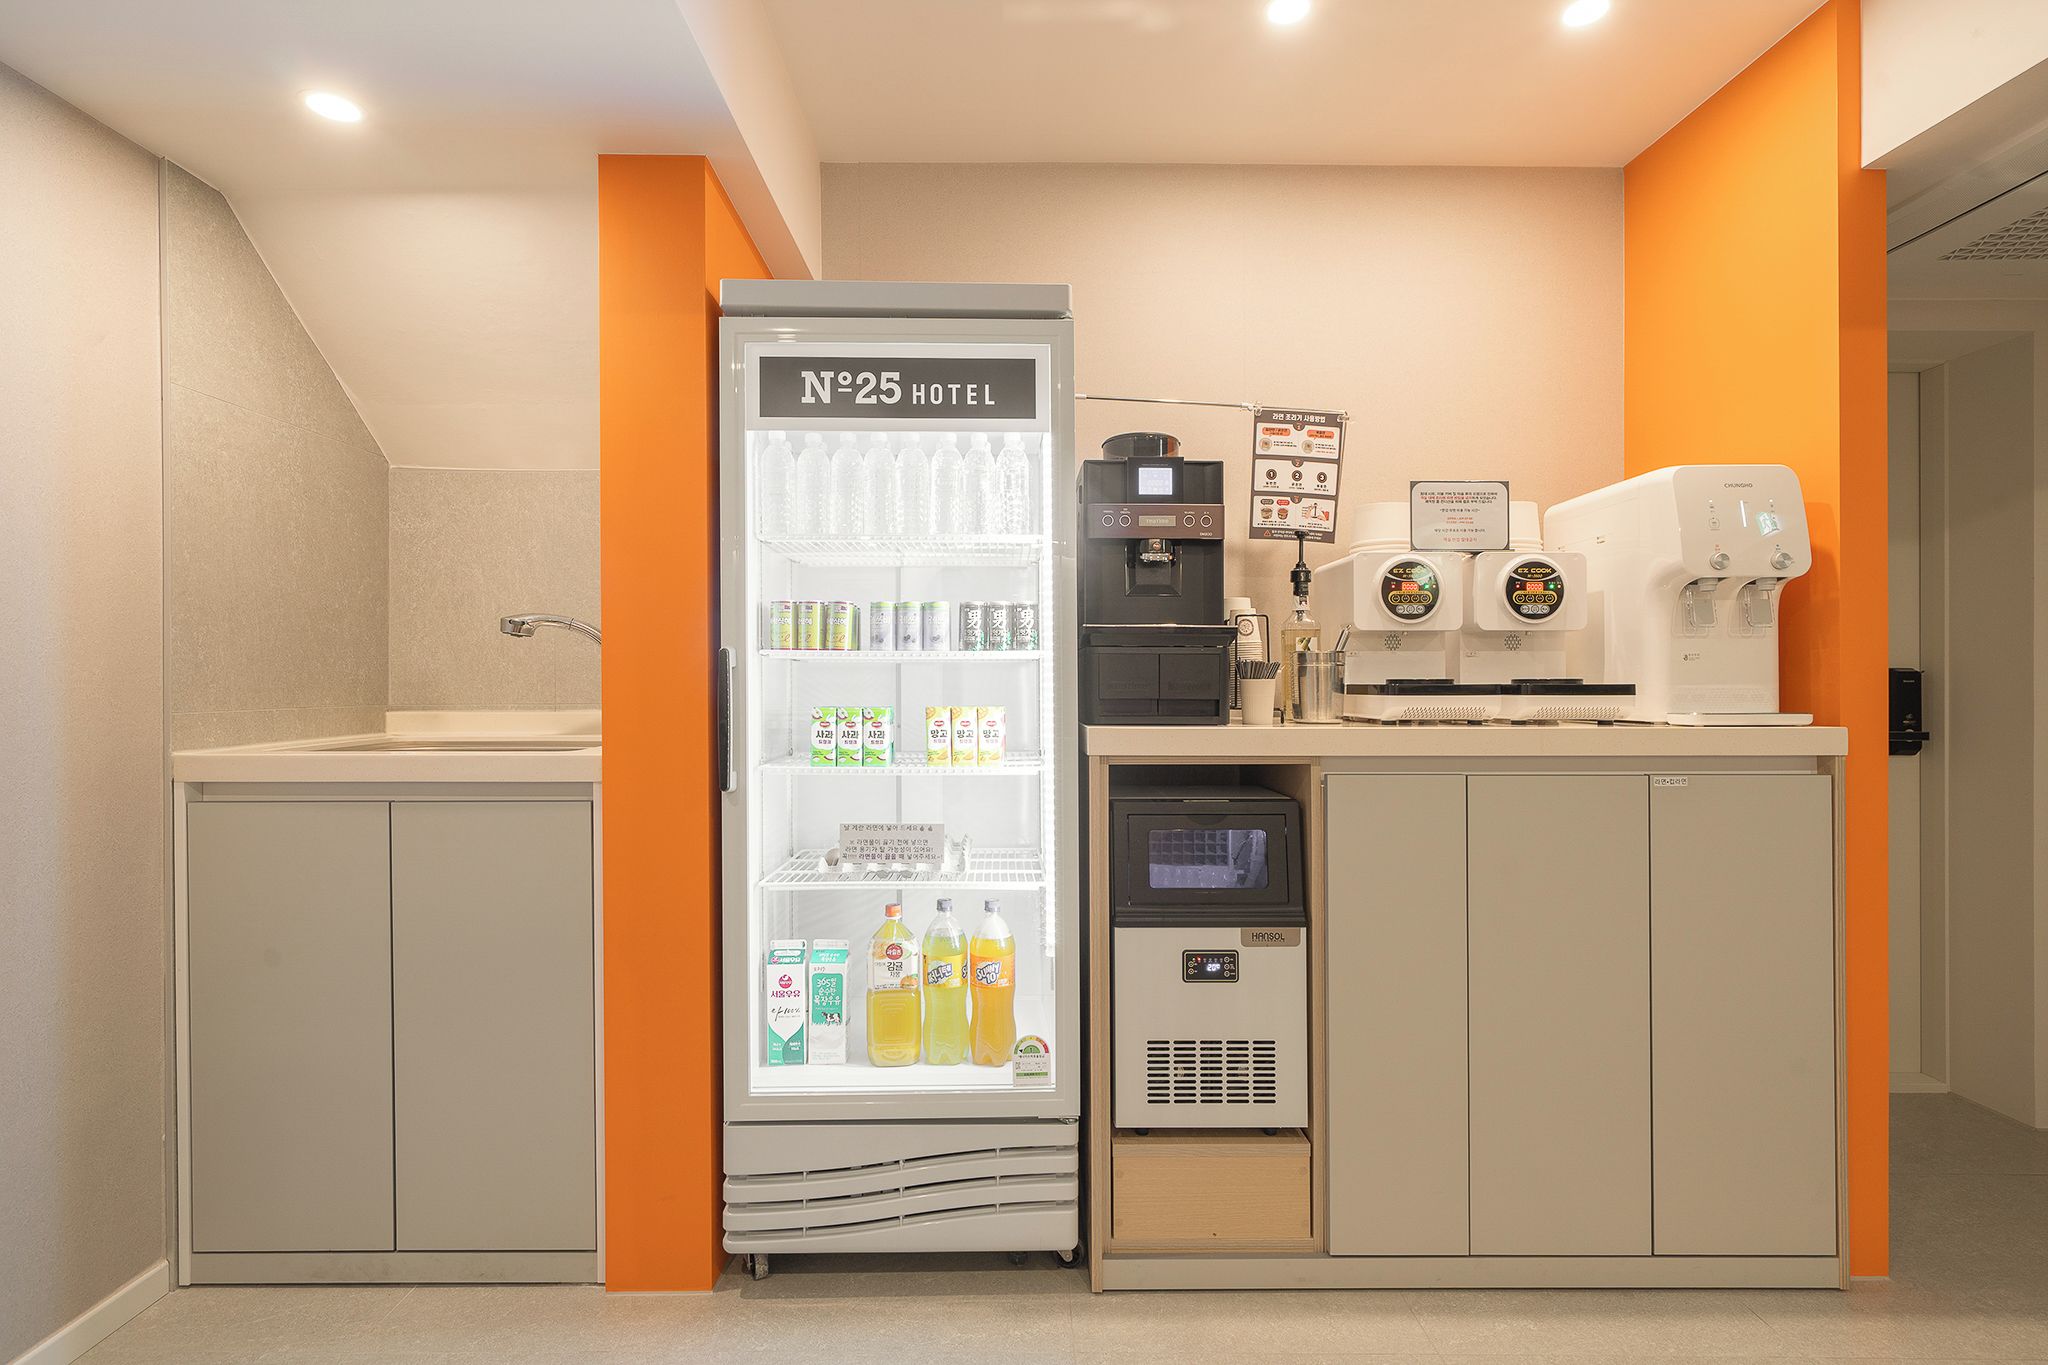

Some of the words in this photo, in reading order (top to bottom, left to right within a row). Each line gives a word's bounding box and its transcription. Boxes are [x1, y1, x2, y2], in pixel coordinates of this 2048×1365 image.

[912, 384, 995, 405] HOTEL
[1272, 412, 1284, 421] 라면
[1285, 413, 1303, 422] 조리기
[816, 730, 834, 739] 사과
[841, 730, 859, 739] 사과
[868, 730, 885, 739] 사과
[931, 729, 948, 739] 망고
[956, 729, 974, 739] 망고
[983, 729, 999, 739] 망고
[866, 824, 884, 832] 라면에
[1251, 932, 1285, 941] HANSOL
[887, 961, 903, 971] 감귤
[976, 961, 1001, 982] SUNNY
[816, 977, 837, 988] 365일
[986, 972, 998, 985] 10
[771, 990, 800, 998] 서울우유
